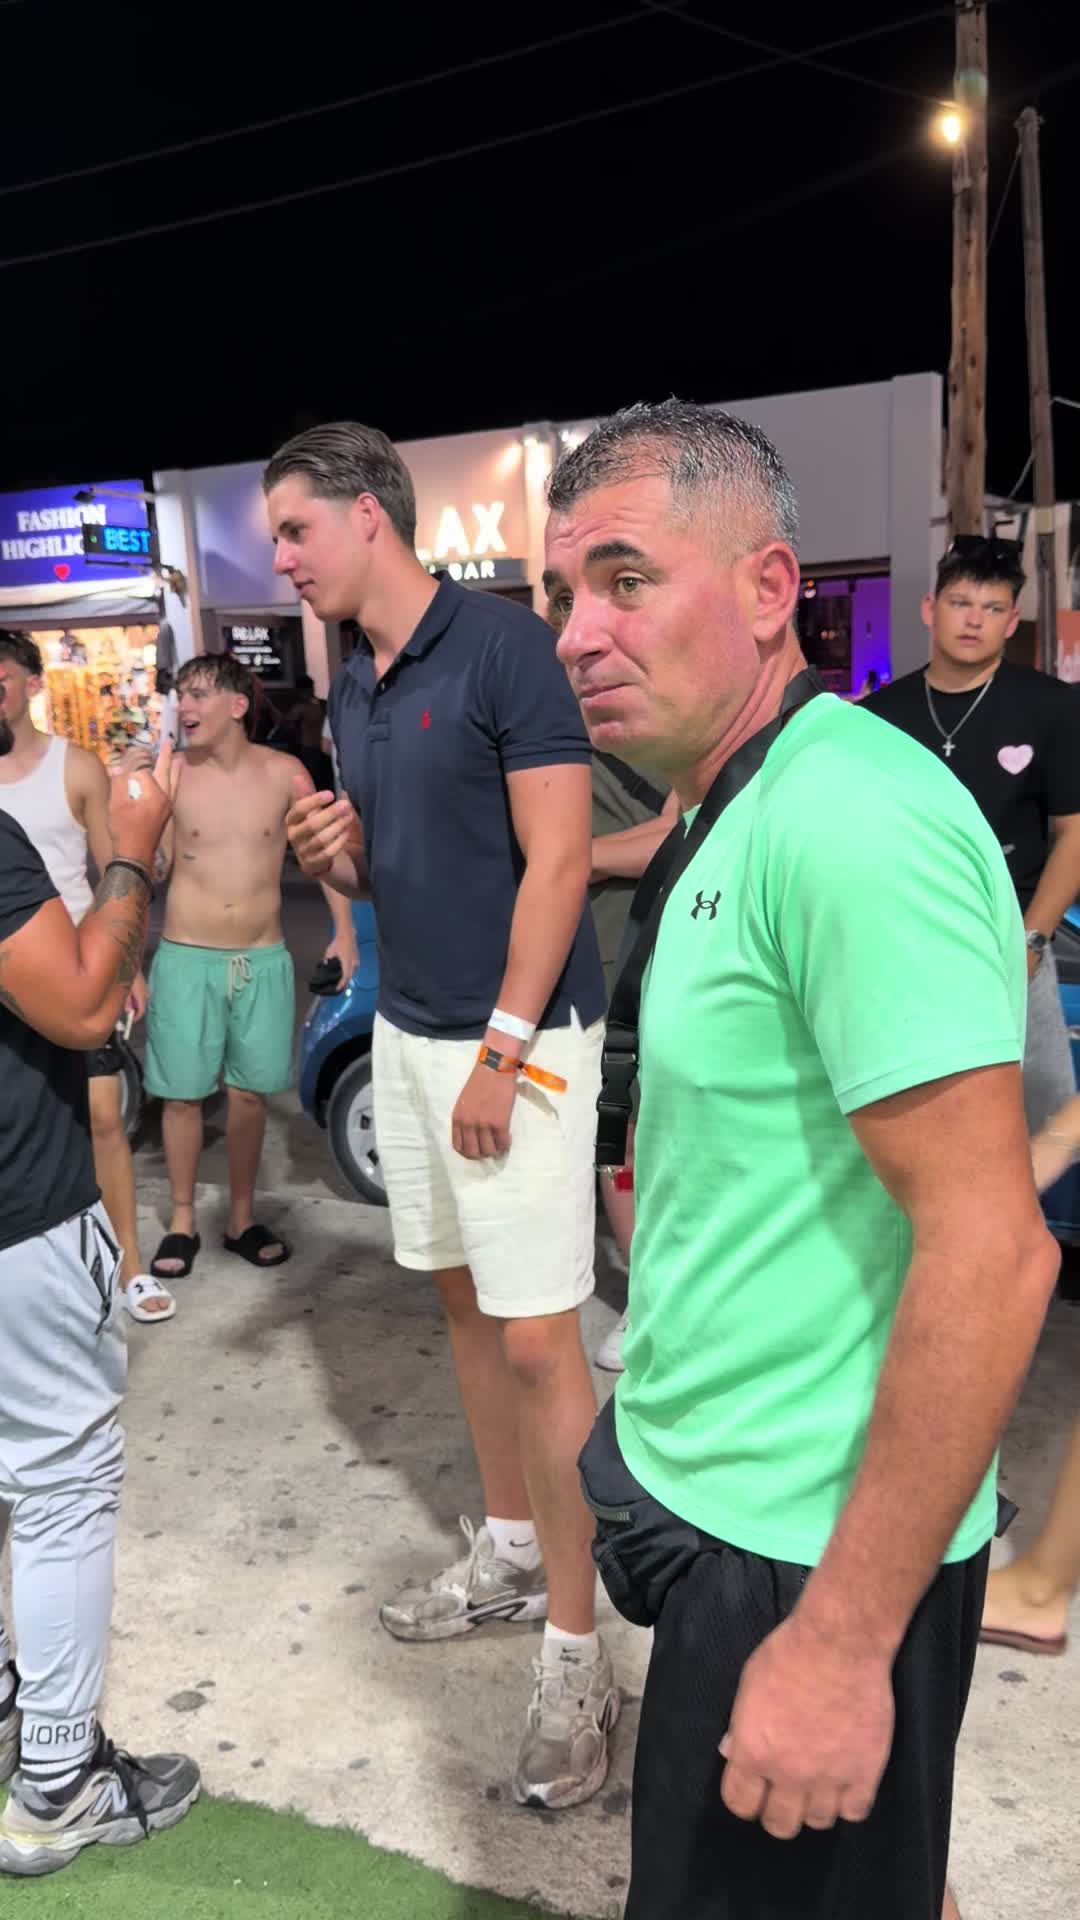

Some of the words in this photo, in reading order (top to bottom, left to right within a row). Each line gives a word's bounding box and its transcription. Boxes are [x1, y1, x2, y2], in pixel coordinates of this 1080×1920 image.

[17, 503, 106, 532] FASHION
[416, 502, 507, 559] AX
[103, 527, 150, 553] BEST
[448, 560, 496, 581] BAR
